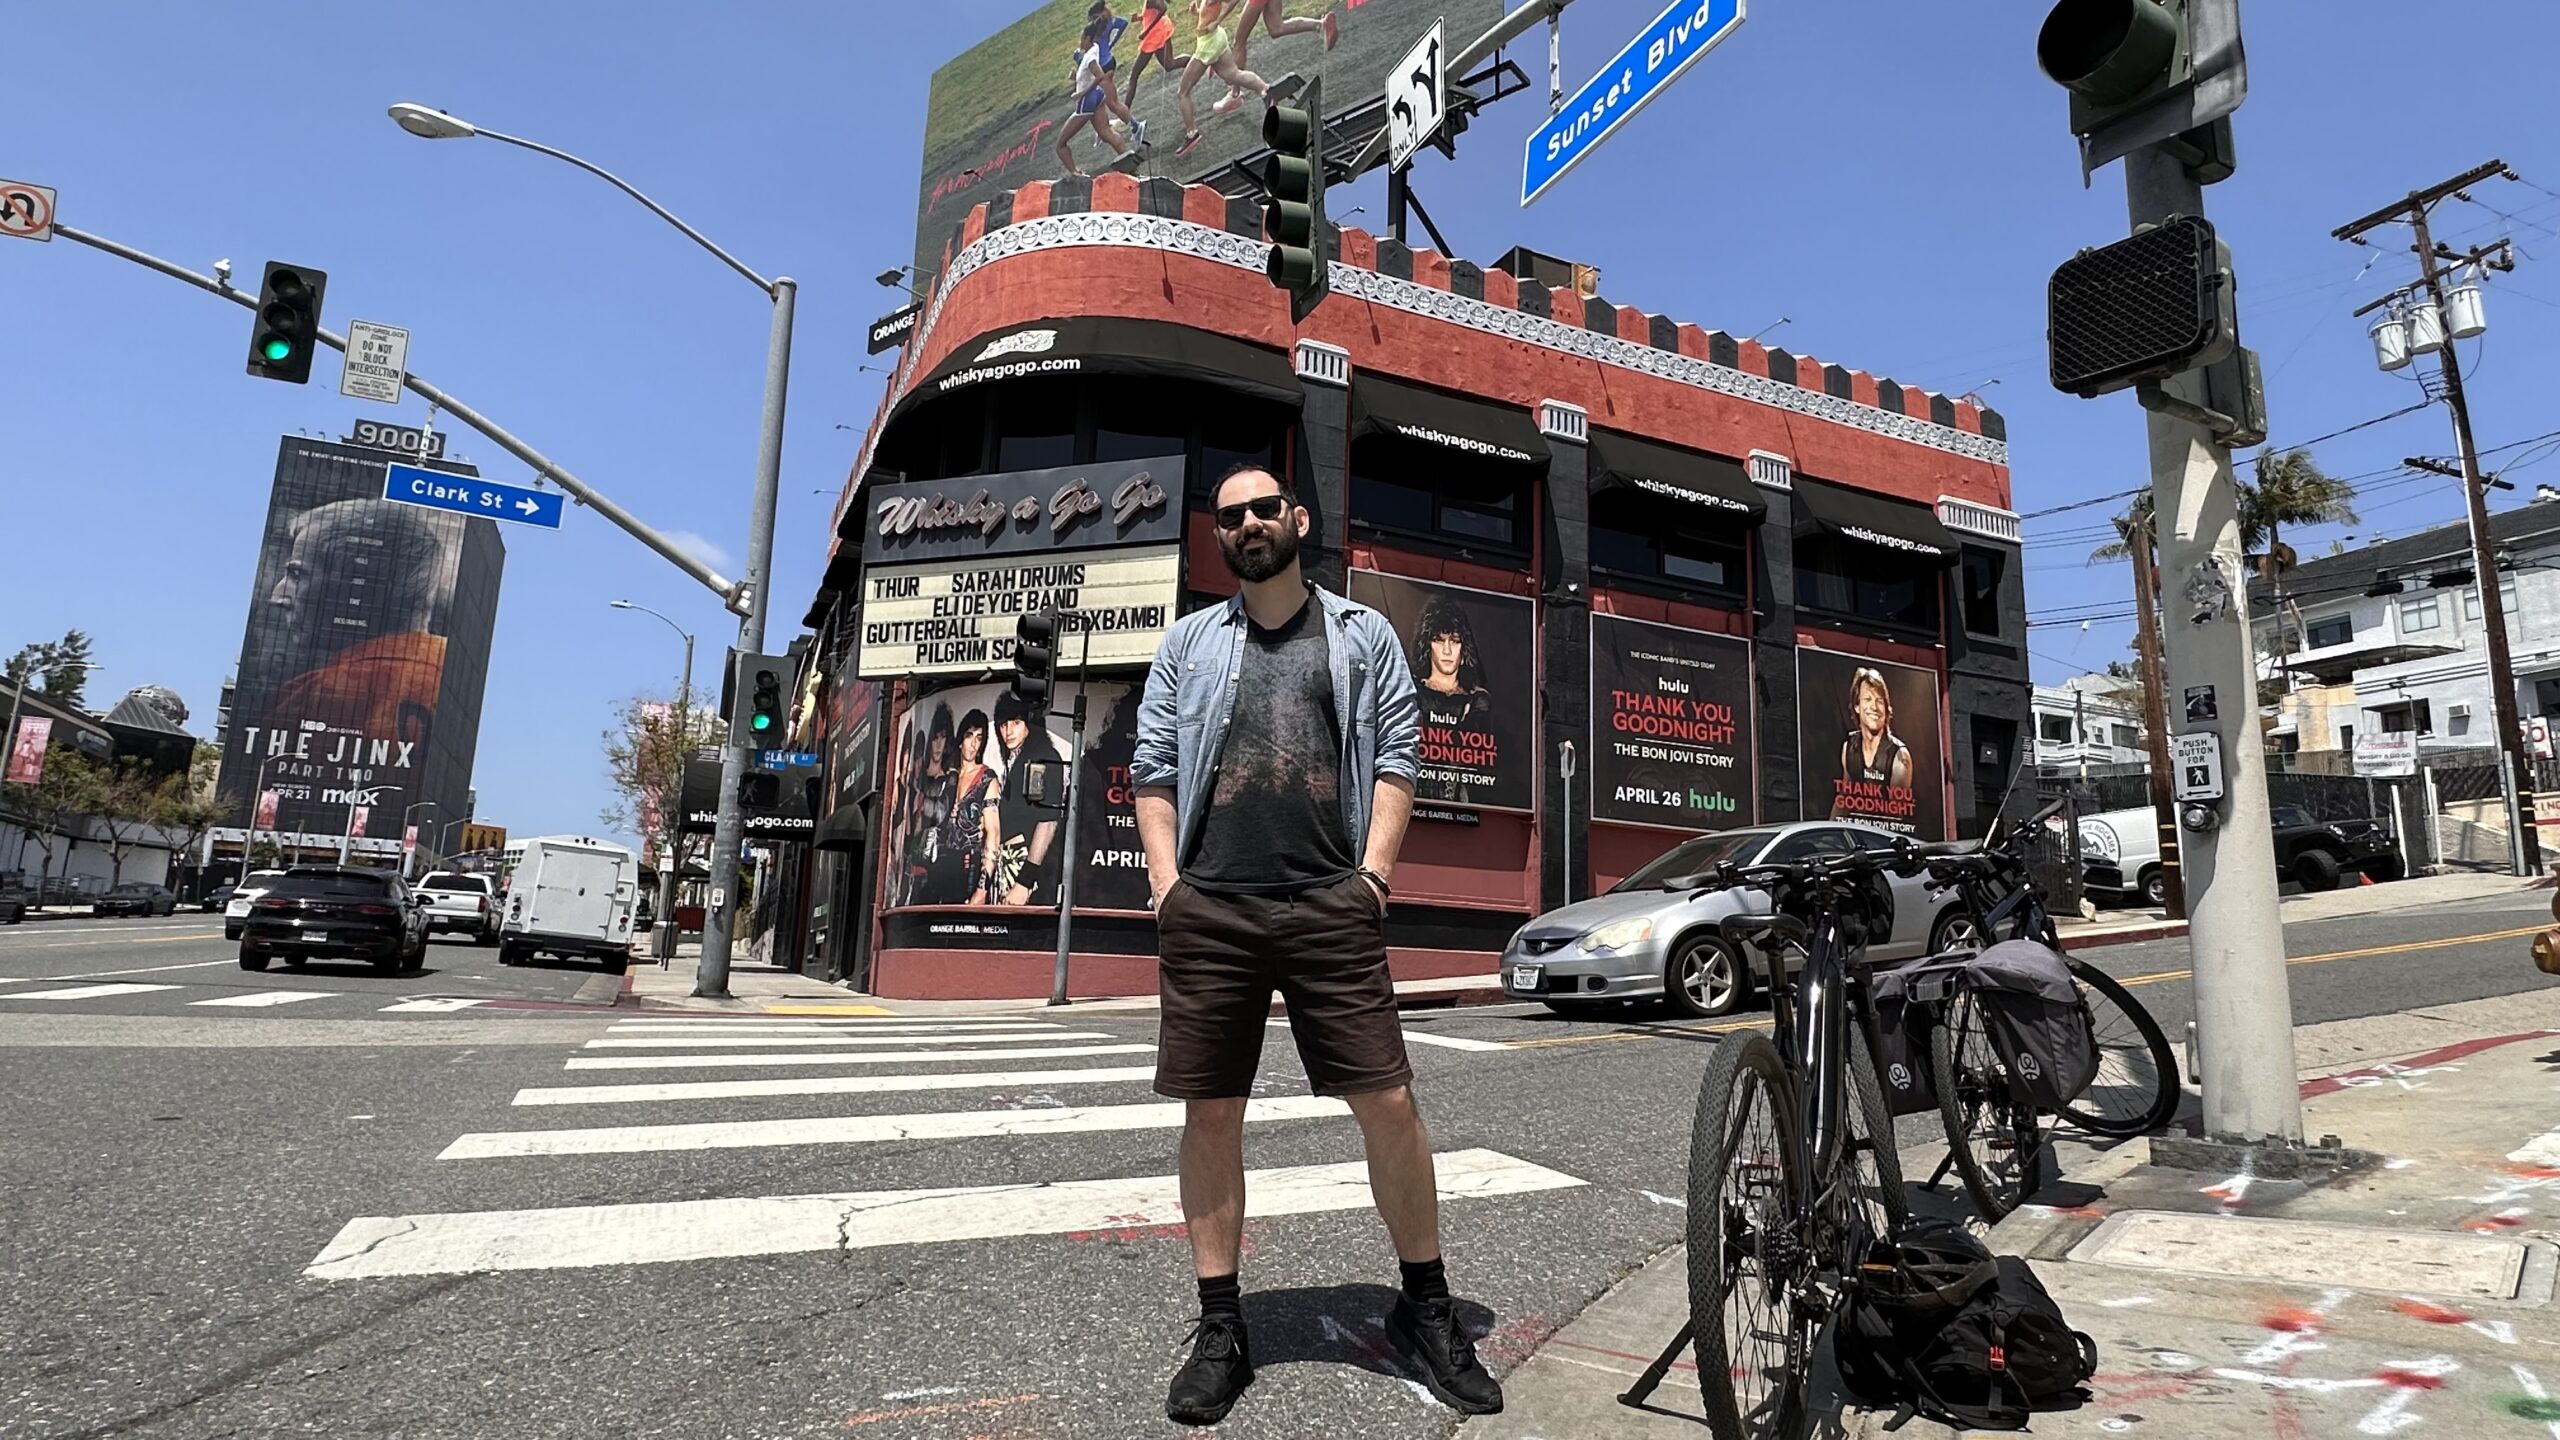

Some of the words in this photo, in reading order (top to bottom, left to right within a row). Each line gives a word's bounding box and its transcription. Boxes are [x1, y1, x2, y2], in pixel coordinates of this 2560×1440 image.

[1546, 67, 1633, 161] Sunset
[1648, 0, 1710, 74] Blvd
[1393, 127, 1415, 162] ONLY
[873, 312, 916, 341] ORANGE
[362, 340, 374, 351] DO
[377, 344, 393, 354] NOT
[363, 352, 388, 365] BLOCK
[348, 361, 400, 379] INTERSECTION
[939, 358, 1081, 391] whiskyagogo.com
[358, 423, 441, 454] 9000
[1397, 425, 1532, 461] whiskyagogo.com
[411, 478, 469, 502] Clark
[480, 492, 503, 508] St
[877, 488, 1006, 536] Whisky
[1011, 496, 1040, 520] a
[1049, 477, 1102, 531] Go
[1111, 471, 1168, 526] Go
[1634, 479, 1749, 512] whiskyagogo.com
[1841, 526, 1941, 555] whiskyagogo.com
[874, 576, 920, 599] THUR
[952, 569, 1015, 593] SARAH
[1020, 564, 1085, 588] DRUMS
[933, 597, 959, 618] ELI
[1026, 588, 1078, 610] BAND
[866, 616, 981, 644] GUTTERBALL
[916, 639, 987, 665] PILGRIM
[1658, 676, 1689, 694] hulu
[1430, 710, 1457, 725] hulu
[1611, 689, 1686, 718] THANK
[1691, 701, 1735, 726] YOU,
[300, 719, 326, 732] HBO
[1612, 712, 1736, 745] GOODNIGHT
[244, 727, 313, 760] THE
[327, 736, 414, 768] JINX
[1418, 726, 1454, 744] ANK
[1459, 730, 1498, 751] YOU,
[2183, 739, 2207, 748] PUSH
[1418, 743, 1498, 766] ODNIGHT
[1613, 743, 1639, 757] THE
[1642, 746, 1667, 761] BON
[1669, 750, 1694, 764] JOVI
[1695, 754, 1735, 768] STORY
[2178, 746, 2214, 757] BUTTON
[2187, 755, 2205, 764] FOR
[277, 761, 324, 778] PART
[336, 767, 373, 782] TWO
[1418, 769, 1436, 780] ON
[1438, 770, 1459, 782] JOVI
[1461, 773, 1496, 786] STORY
[1863, 768, 1885, 780] hulu
[296, 790, 311, 800] 21
[322, 788, 380, 806] max
[1614, 786, 1660, 805] APRIL
[1662, 791, 1681, 807] 26
[1689, 788, 1736, 812] hulu
[1833, 779, 1883, 798] THANK
[1887, 786, 1916, 803] YOU,
[1835, 794, 1916, 816] GOODNIGHT
[690, 810, 813, 829] whisgogo.com
[1107, 815, 1136, 827] THE
[1456, 812, 1479, 823] MEDIA
[1854, 818, 1872, 827] BON
[1873, 820, 1889, 831] JOVI
[1890, 822, 1916, 833] STORY
[2094, 825, 2116, 853] ROCKIES
[1091, 849, 1149, 869] APRIL
[930, 925, 954, 933] ORANGE
[955, 925, 980, 934] BARREL
[983, 926, 1008, 934] MEDIA
